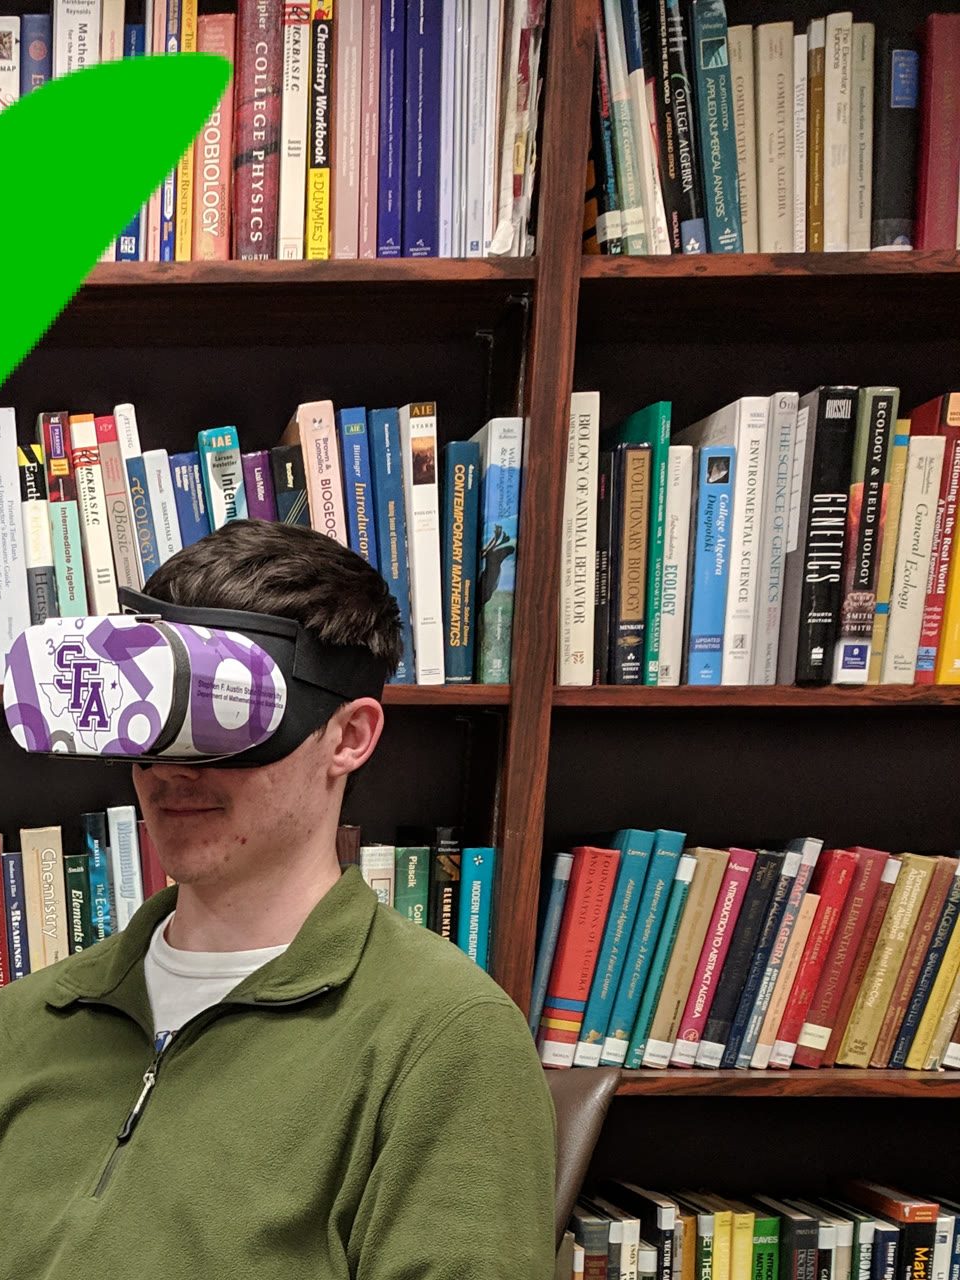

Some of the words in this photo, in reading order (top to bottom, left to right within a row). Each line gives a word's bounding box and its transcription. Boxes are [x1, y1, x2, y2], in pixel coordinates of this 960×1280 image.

[313, 23, 329, 96] Chemistry
[833, 28, 842, 70] Functions
[252, 41, 268, 142] COLLEGE
[314, 94, 330, 165] Workbook
[250, 150, 265, 242] PHYSICS
[412, 405, 434, 416] AIE
[778, 398, 797, 410] 6th
[825, 400, 852, 419] RUSSELL
[211, 435, 233, 448] IAE
[576, 414, 591, 475] BIOLOGY
[779, 424, 792, 451] THE
[871, 401, 887, 462] ECOLOGY
[24, 462, 41, 501] Earth
[580, 474, 590, 491] OF
[742, 439, 761, 547] ENVIRONMENTAL
[775, 453, 789, 514] SCIENCE
[870, 466, 880, 476] &
[450, 464, 466, 563] CONTEMPORARY
[575, 492, 589, 553] ANIMAL
[628, 456, 645, 552] EVOLUTIONARY
[704, 493, 717, 553] Dugopolski
[715, 493, 730, 533] College
[773, 514, 785, 534] OF
[866, 481, 878, 524] FIELD
[60, 507, 72, 563] Intermediate
[66, 565, 75, 601] Algebra
[714, 533, 728, 576] Algebra
[806, 493, 848, 584] GENETICS
[859, 527, 874, 586] BIOLOGY
[910, 503, 929, 559] General
[573, 555, 587, 624] BEHAVIOR
[626, 553, 642, 615] BIOLOGY
[738, 550, 752, 603] SCIENCE
[768, 534, 785, 602] GENETICS
[898, 559, 919, 610] Ecology
[449, 563, 464, 648] MATHEMATICS
[226, 685, 243, 695] Austin
[40, 847, 59, 940] Chemistry
[407, 855, 418, 888] Piascik
[900, 868, 917, 909] Abstract
[71, 889, 84, 942] Elements
[889, 908, 907, 940] Algebra
[903, 869, 928, 932] Fundamentals
[884, 947, 894, 967] Neal
[866, 975, 884, 1008] McCoy
[663, 1238, 672, 1268] VECTOR
[887, 1241, 897, 1267] Linear
